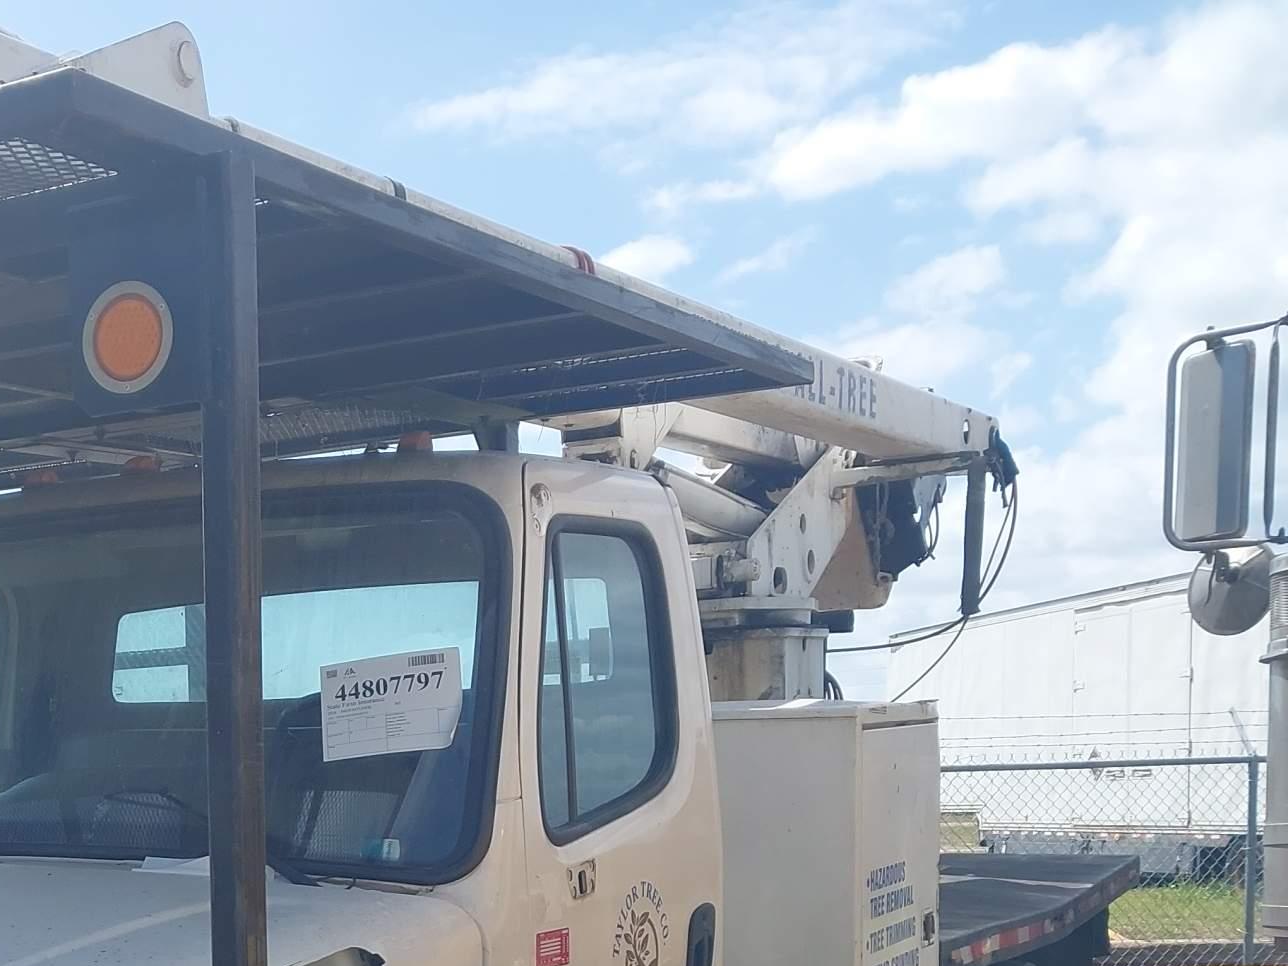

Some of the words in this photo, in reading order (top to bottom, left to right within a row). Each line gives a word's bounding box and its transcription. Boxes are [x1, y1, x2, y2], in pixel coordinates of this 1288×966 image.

[334, 670, 444, 702] 44807797
[870, 860, 906, 892] HAZARDOUS
[612, 885, 639, 958] TAYLOR
[640, 881, 663, 914] TREE
[870, 895, 885, 920] TREE
[886, 885, 914, 914] REMOVAL
[870, 928, 885, 954] TREE
[886, 915, 916, 948] TRIMMING
